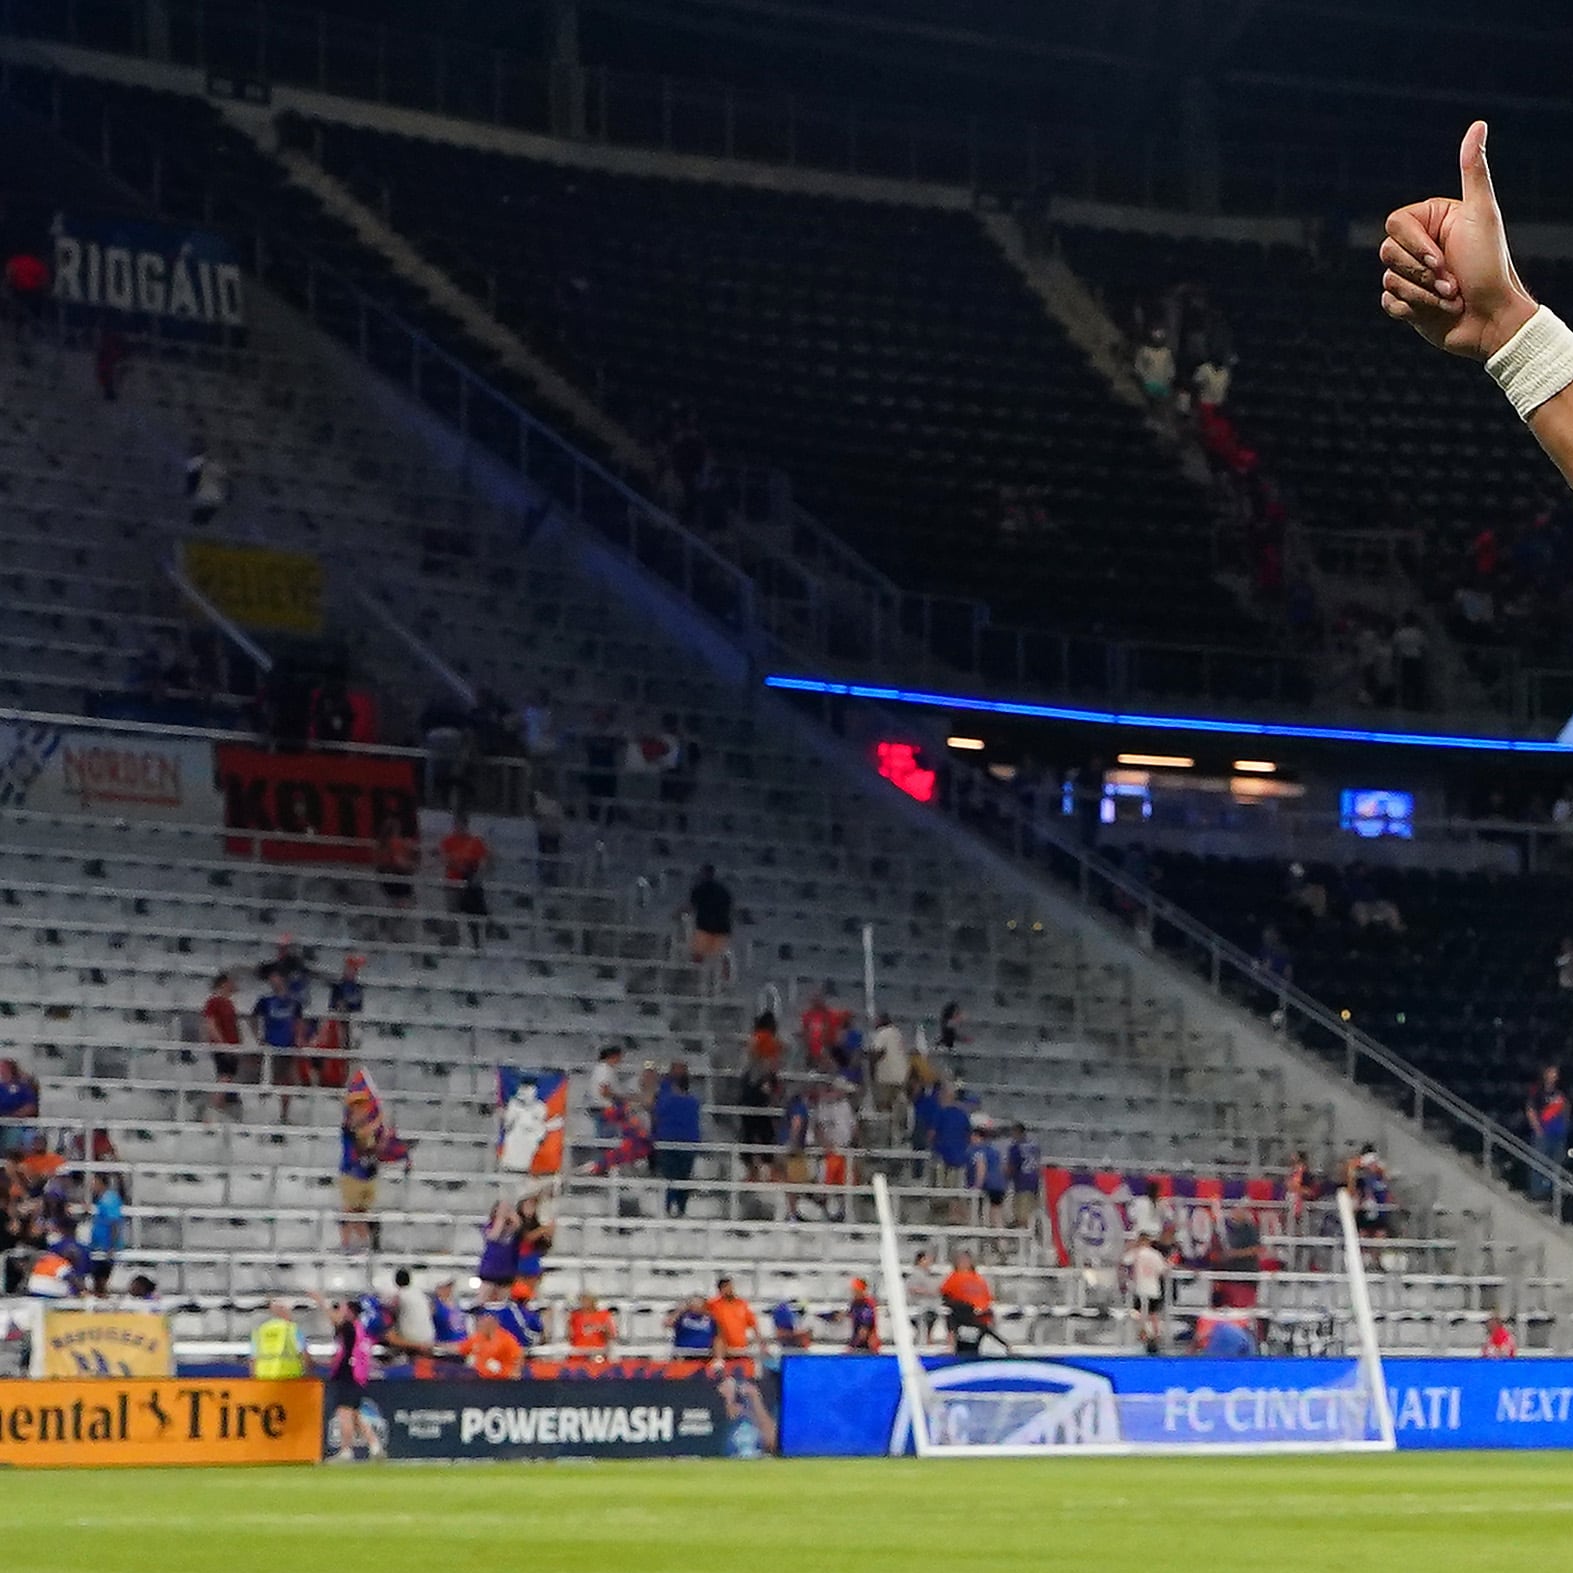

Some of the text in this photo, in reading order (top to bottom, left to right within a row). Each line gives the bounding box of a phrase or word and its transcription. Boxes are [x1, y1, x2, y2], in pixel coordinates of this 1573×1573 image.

[0, 1388, 287, 1441] ental Tire
[461, 1406, 674, 1444] POWERWASH
[1164, 1387, 1214, 1432] FC
